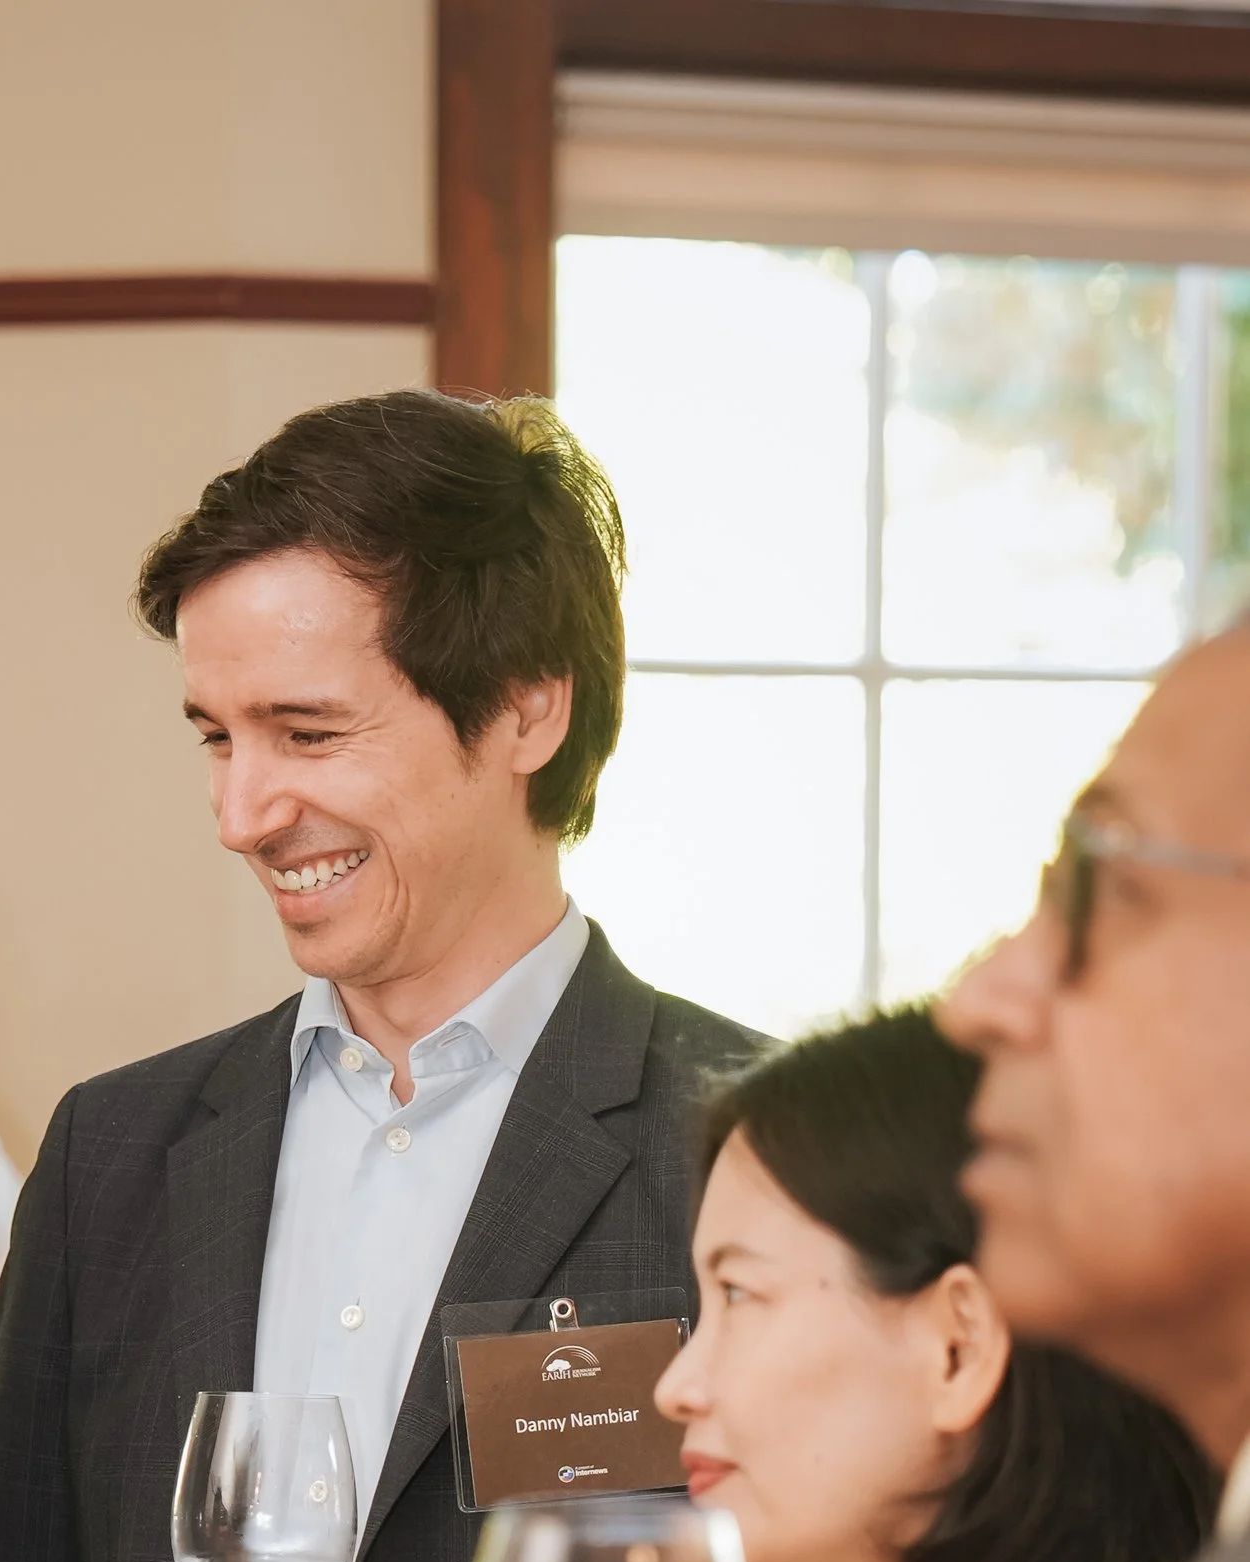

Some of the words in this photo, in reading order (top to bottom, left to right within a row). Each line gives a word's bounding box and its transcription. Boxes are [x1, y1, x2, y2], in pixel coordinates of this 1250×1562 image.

[542, 1369, 570, 1381] EARTH
[515, 1417, 566, 1433] Danny
[570, 1408, 639, 1428] Nambiar
